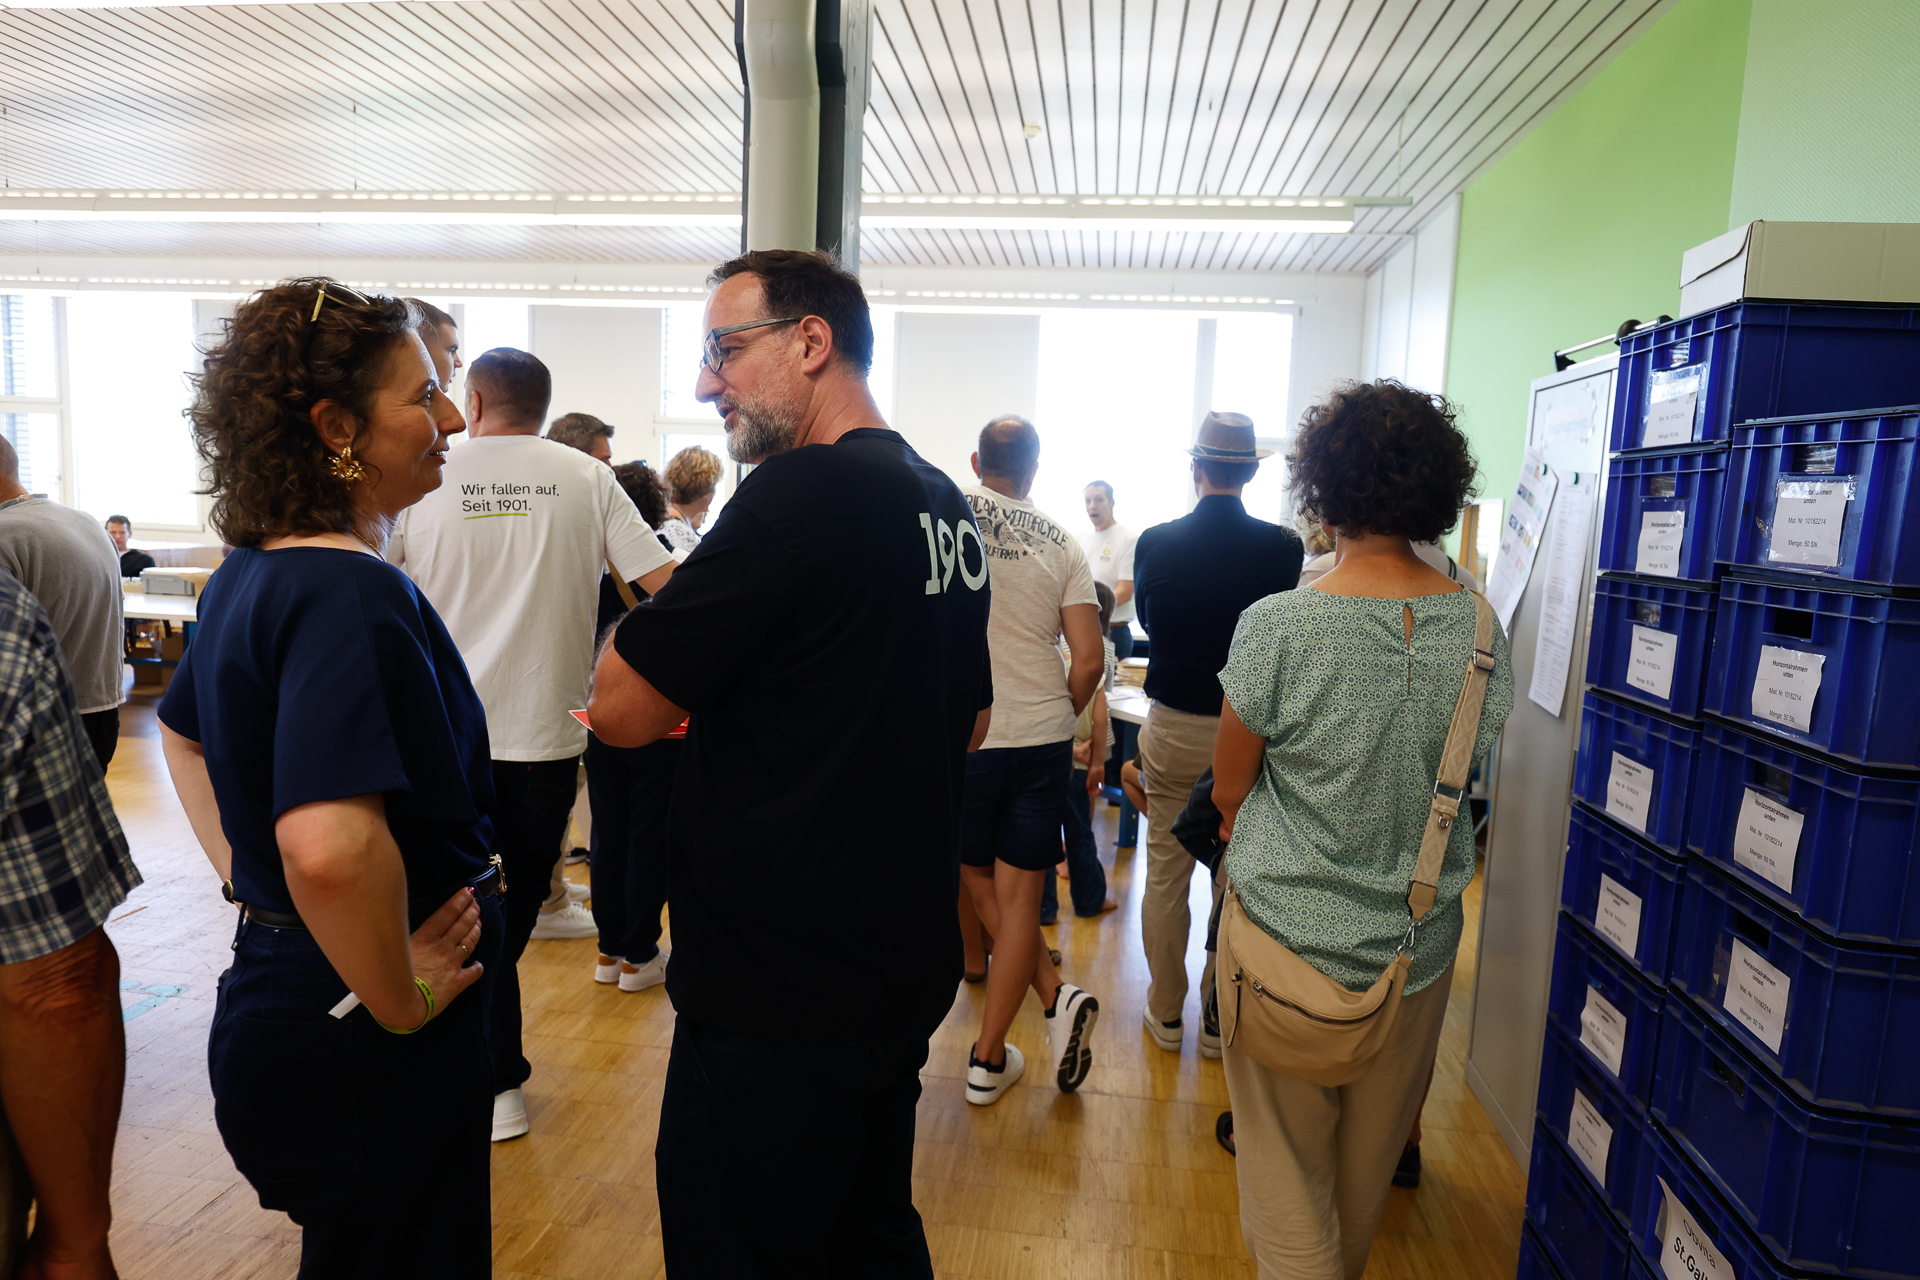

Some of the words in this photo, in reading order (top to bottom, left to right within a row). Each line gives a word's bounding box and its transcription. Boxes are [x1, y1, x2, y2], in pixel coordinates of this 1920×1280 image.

[461, 484, 486, 496] Wir
[491, 483, 530, 496] fallen
[535, 484, 560, 496] auf.
[462, 500, 491, 512] Seit
[496, 499, 532, 512] 1901.
[919, 512, 992, 595] 190
[1773, 660, 1808, 672] Horizontalrahmen
[1785, 692, 1801, 700] 10182214
[1769, 710, 1782, 719] Menge:
[1755, 799, 1789, 820] Horizontalrahmen
[1764, 813, 1776, 822] unten
[1764, 833, 1782, 847] 10182214
[1750, 848, 1762, 860] Menge:
[1744, 958, 1776, 987] Horizontalrahmen
[1752, 975, 1763, 986] unten
[1674, 1236, 1708, 1280] St.Gal
